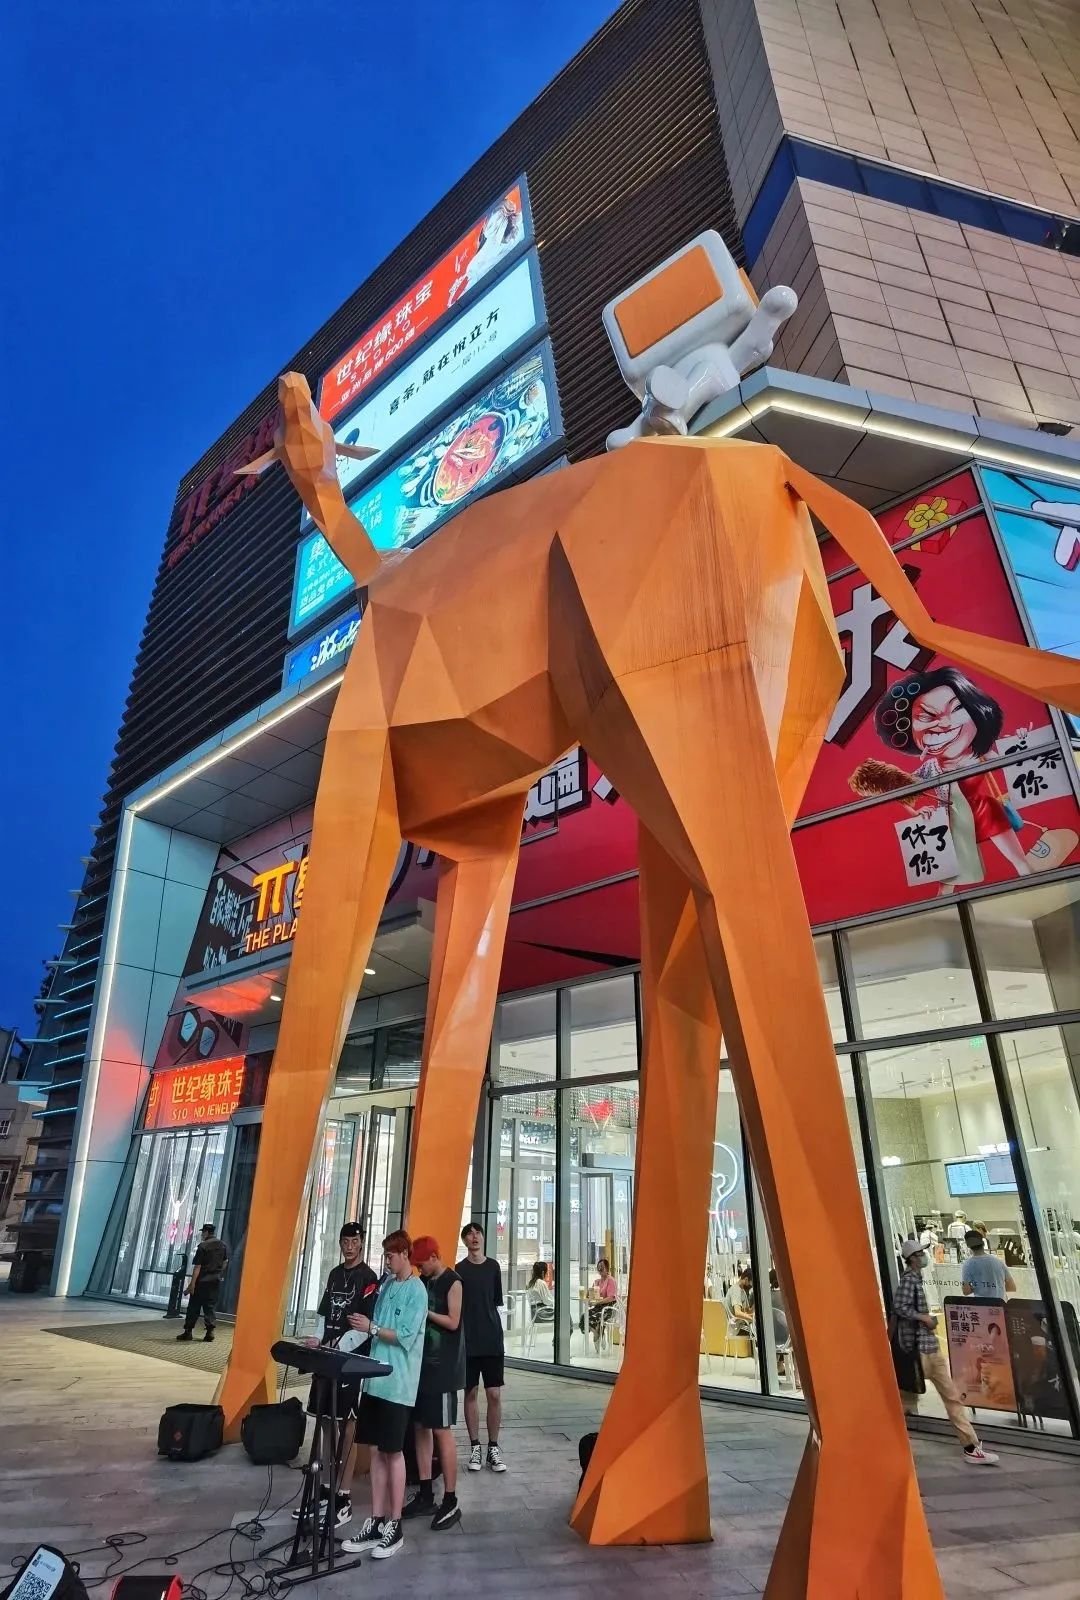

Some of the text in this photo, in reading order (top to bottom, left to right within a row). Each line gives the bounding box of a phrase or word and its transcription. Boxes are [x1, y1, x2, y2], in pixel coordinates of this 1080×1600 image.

[336, 280, 434, 385] 世纪缘珠宝
[1013, 770, 1048, 799] 你
[902, 824, 949, 852] 休了
[909, 850, 939, 877] 你
[245, 928, 271, 953] THE
[922, 1279, 965, 1287] NSPIRATION
